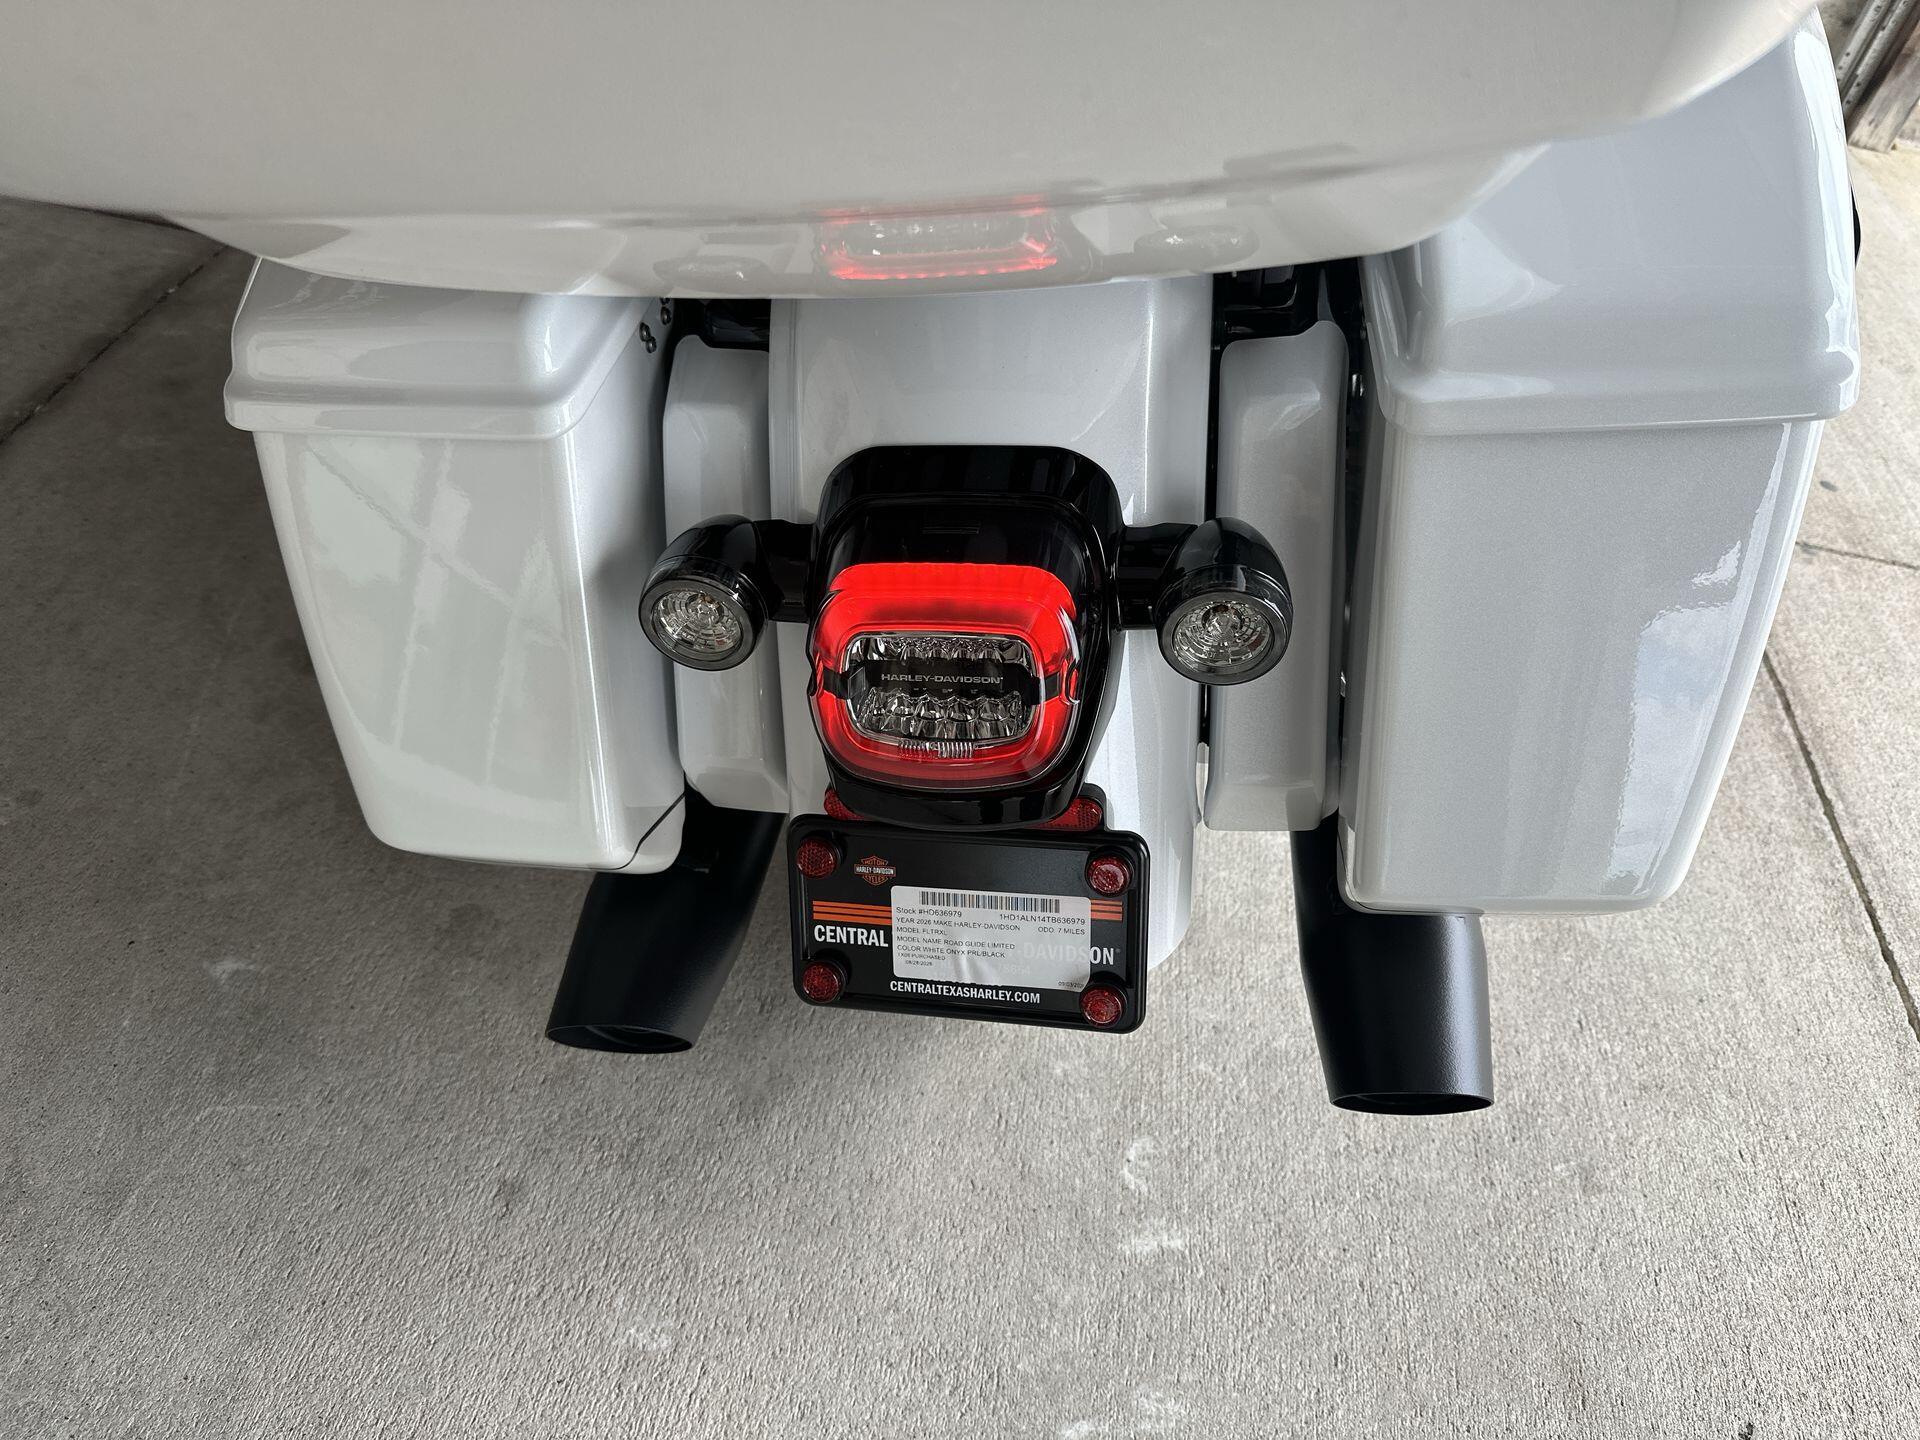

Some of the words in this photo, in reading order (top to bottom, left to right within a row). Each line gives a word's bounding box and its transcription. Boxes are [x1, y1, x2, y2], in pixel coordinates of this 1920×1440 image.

[881, 673, 1001, 684] HARLEY-DAVIDSON
[855, 866, 894, 875] HARLEY-DAVIDSON
[896, 906, 916, 915] Stock
[918, 908, 962, 918] #HD636979
[933, 919, 953, 927] MAKE
[954, 920, 1021, 931] HARLEY-DAVIDSON
[999, 913, 1086, 925] 1HD1ALN14TB636979
[814, 924, 889, 948] CENTRAL
[896, 926, 920, 934] MODEL
[896, 935, 920, 943] MODEL
[965, 940, 985, 948] GLIDE
[987, 942, 1016, 950] LIMITED
[896, 944, 921, 952] COLOR
[922, 946, 945, 954] WHITE
[946, 948, 966, 956] ONYX
[889, 980, 1041, 1004] CENTRALTEXASHARLEY.COM
